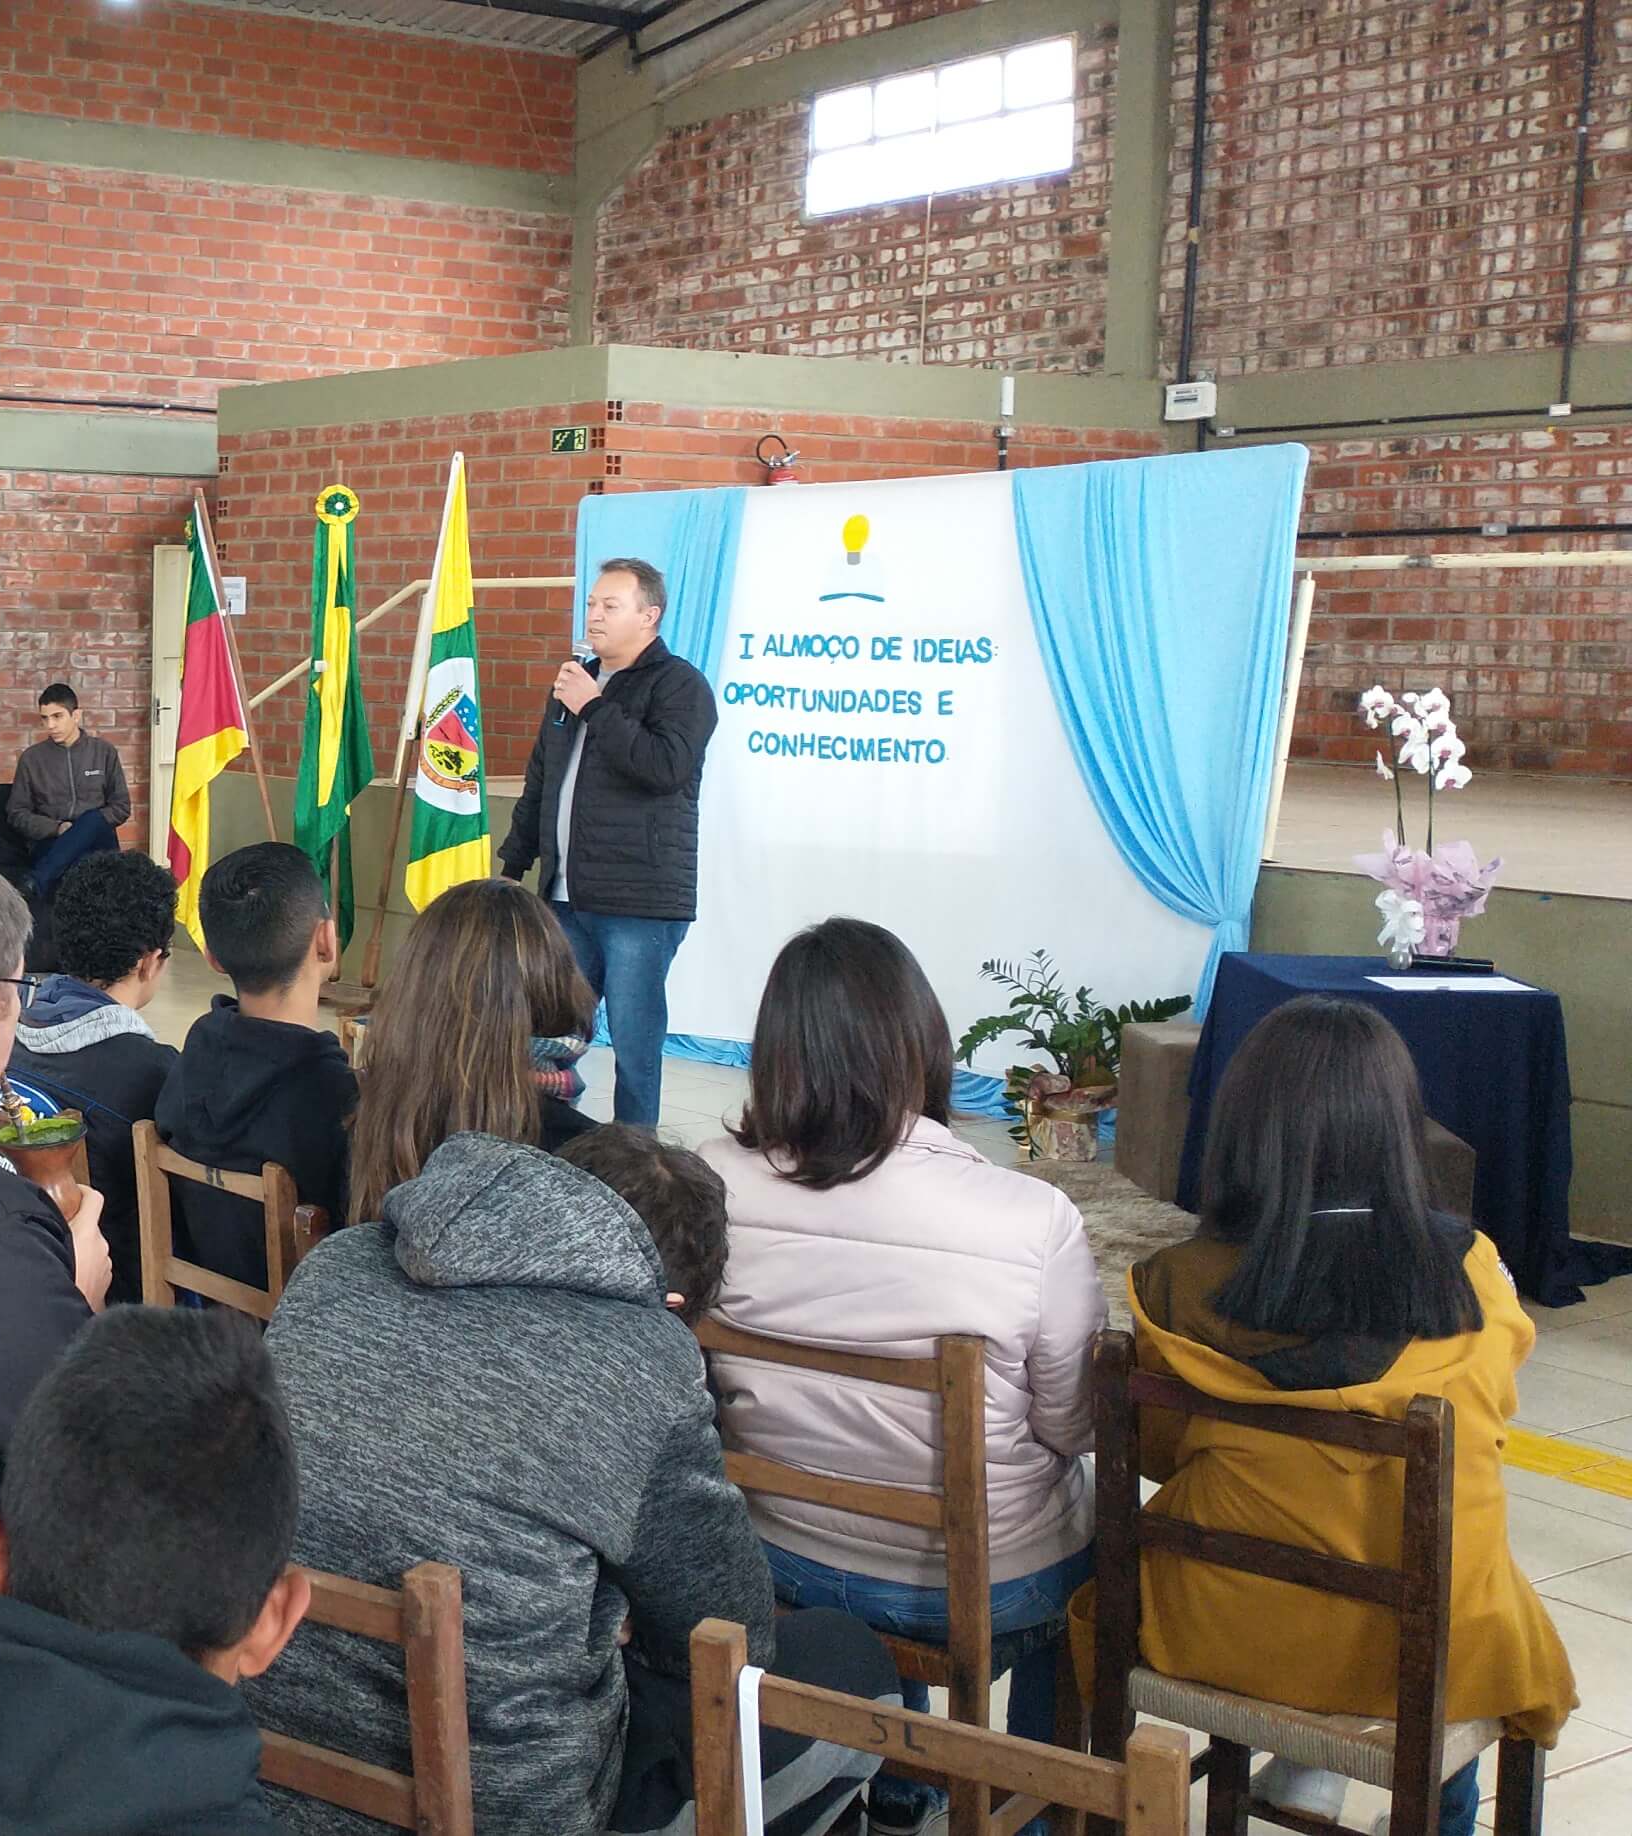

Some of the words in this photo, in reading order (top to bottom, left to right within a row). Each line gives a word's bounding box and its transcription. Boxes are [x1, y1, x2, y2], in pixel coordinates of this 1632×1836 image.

[739, 633, 755, 660] I
[762, 633, 860, 664] ALMOÇO
[870, 636, 902, 661] DE
[723, 681, 922, 715] OPORTUNIDADES
[937, 690, 954, 715] E
